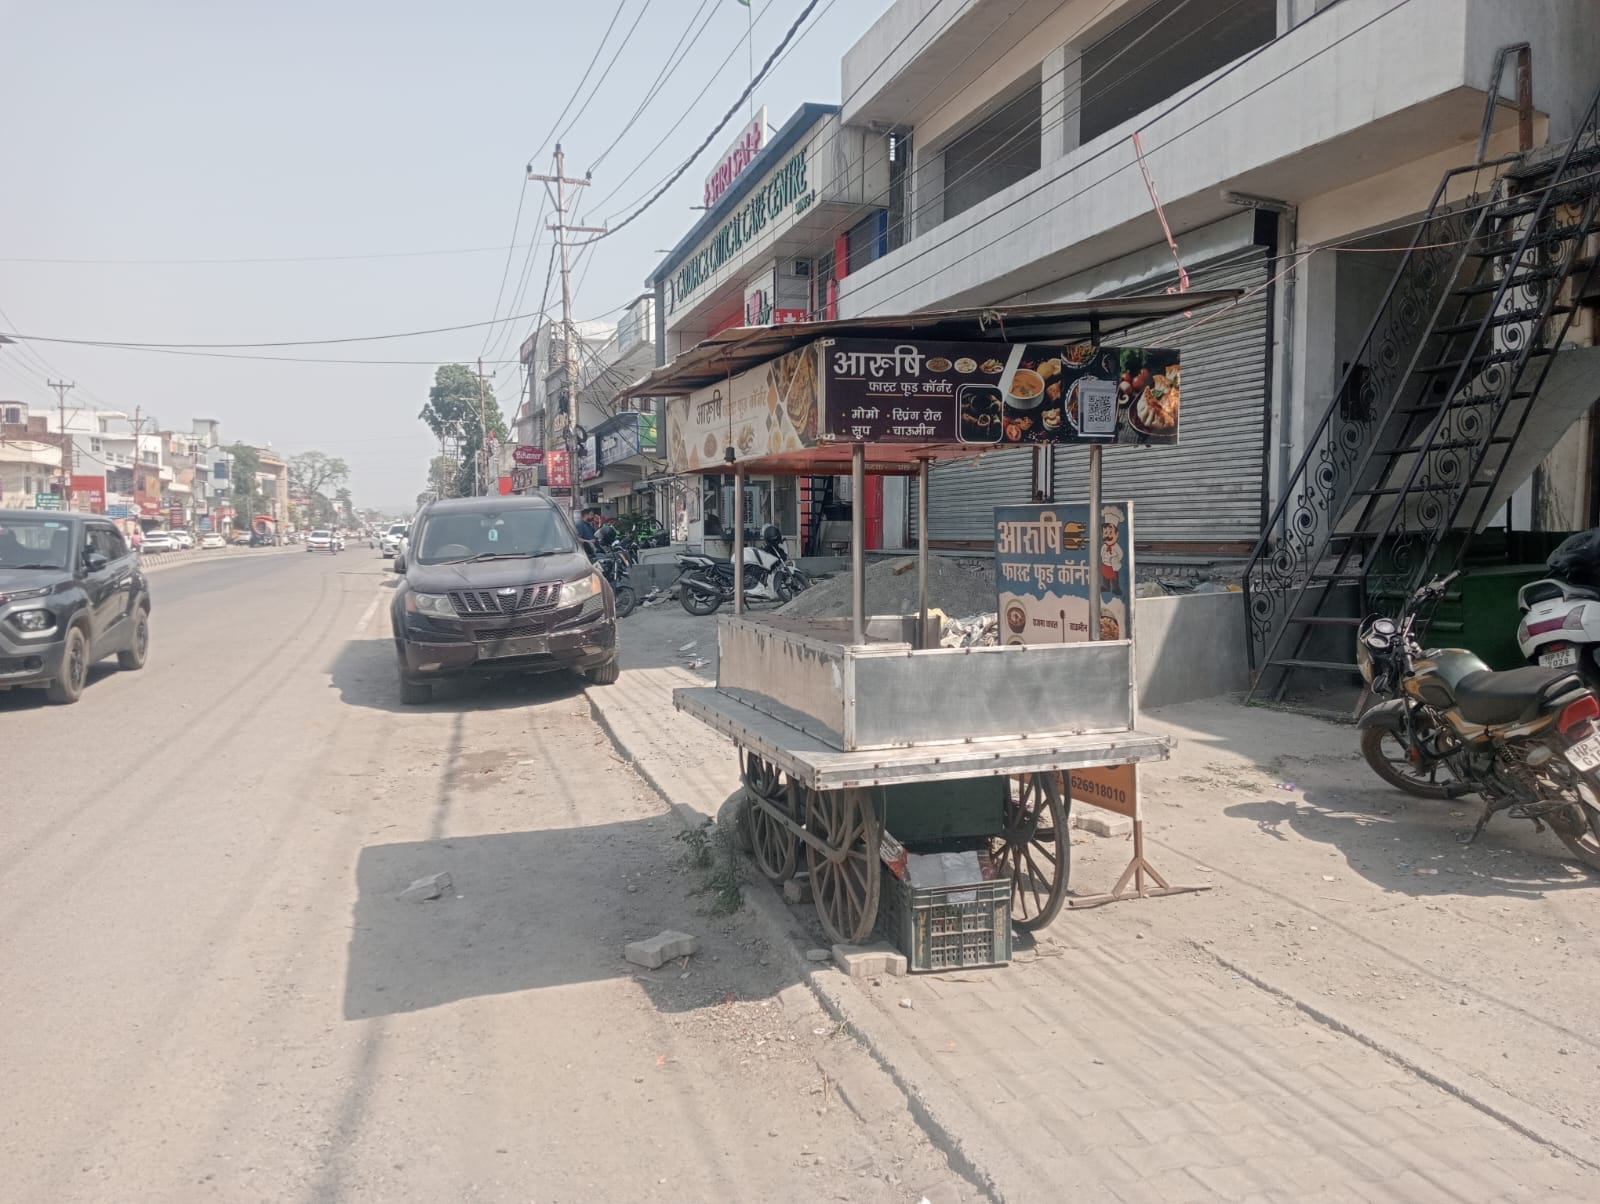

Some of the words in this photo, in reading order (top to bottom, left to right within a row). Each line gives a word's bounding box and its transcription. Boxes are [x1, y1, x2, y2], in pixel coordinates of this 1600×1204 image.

[742, 186, 766, 243] CARE
[767, 145, 807, 220] CENTRE
[833, 344, 926, 377] आरूषि
[868, 381, 897, 392] फास्ट
[900, 382, 919, 397] फूड
[921, 379, 953, 393] कॉर्नर
[851, 406, 880, 420] मोमो
[892, 407, 920, 421] स्प्रिंग
[922, 408, 943, 421] रोल
[851, 425, 872, 439] सूप
[892, 422, 936, 436] चाऊमीन
[1001, 563, 1031, 582] फास्ट
[1033, 563, 1055, 590] फूड
